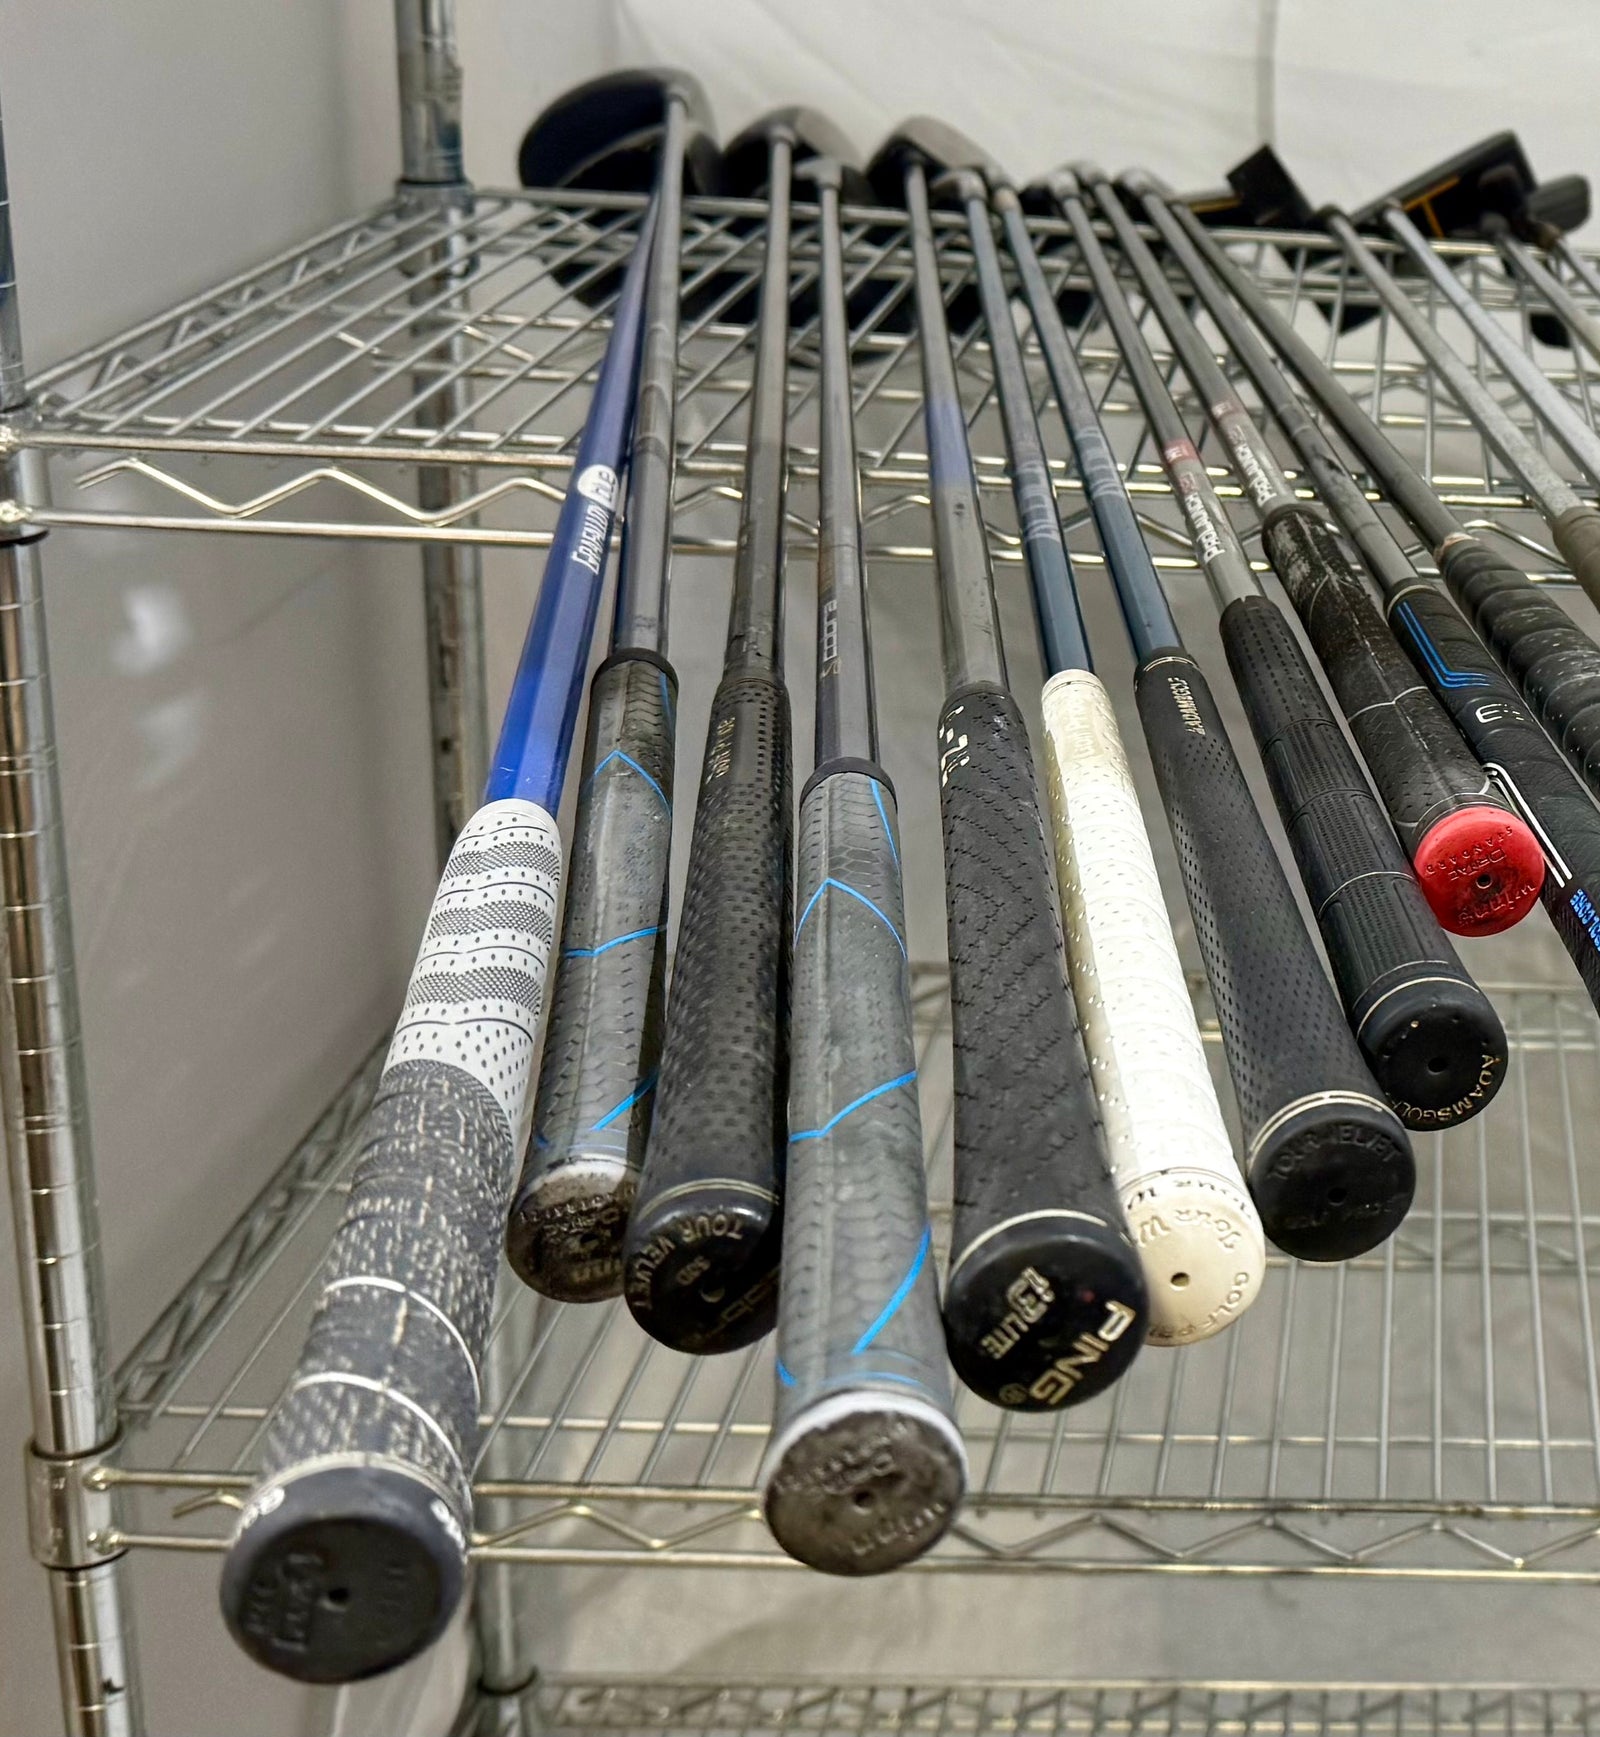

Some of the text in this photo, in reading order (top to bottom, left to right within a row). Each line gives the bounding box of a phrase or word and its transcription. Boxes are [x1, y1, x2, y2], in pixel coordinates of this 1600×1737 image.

[1425, 825, 1513, 876] STANDARD
[629, 1213, 743, 1310] TOUR VELVET
[1202, 1271, 1250, 1330] GOLF
[1029, 1299, 1137, 1405] PING
